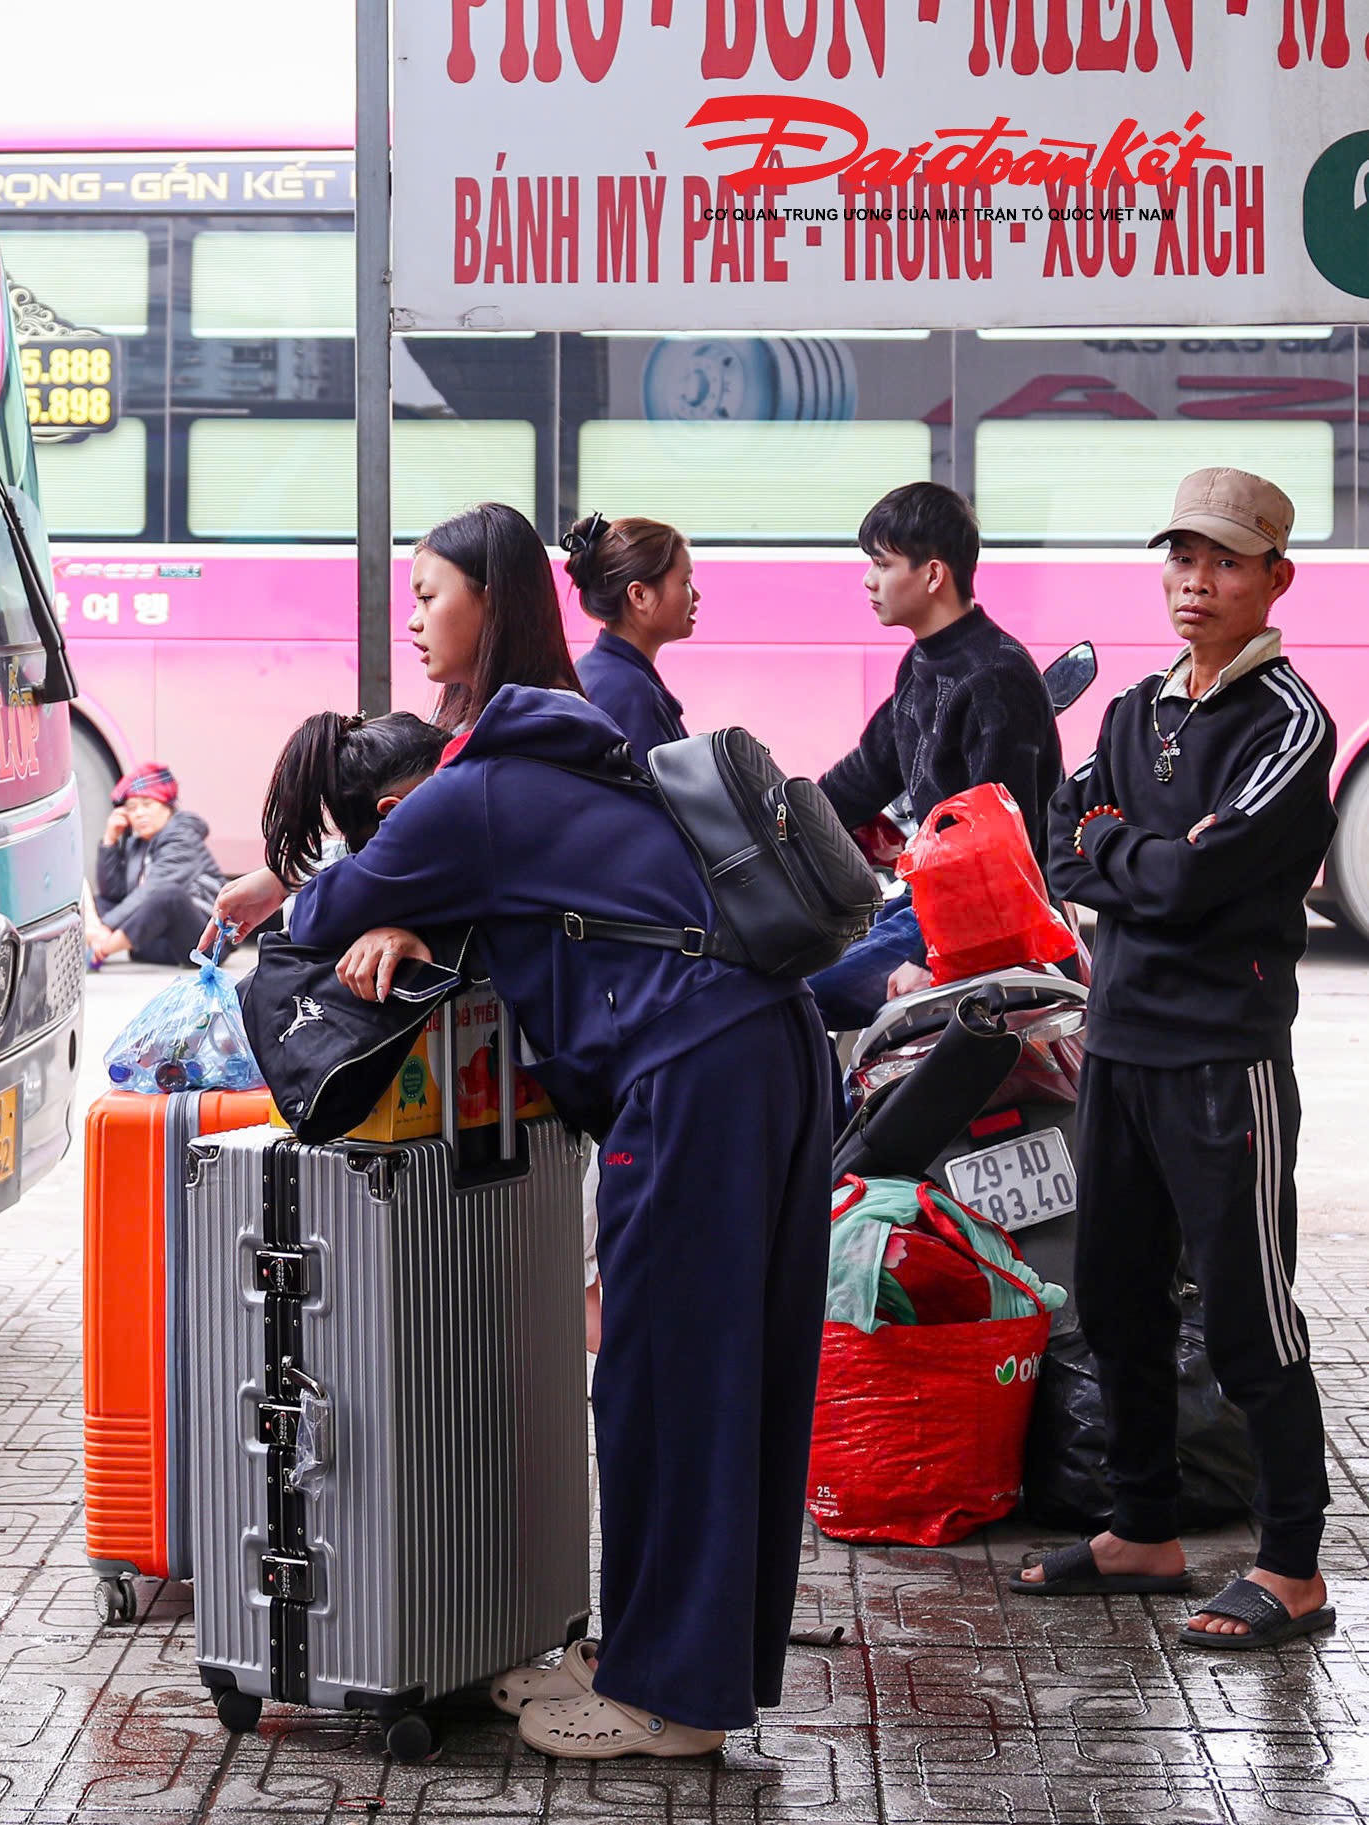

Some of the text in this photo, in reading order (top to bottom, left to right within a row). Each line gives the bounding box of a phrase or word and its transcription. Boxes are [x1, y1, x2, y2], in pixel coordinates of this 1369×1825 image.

[243, 160, 337, 199] KẾT
[454, 151, 579, 284] BÁNH
[597, 151, 667, 283] MỲ
[683, 150, 788, 283] PATÊ
[966, 1140, 1051, 1194] 29-AD
